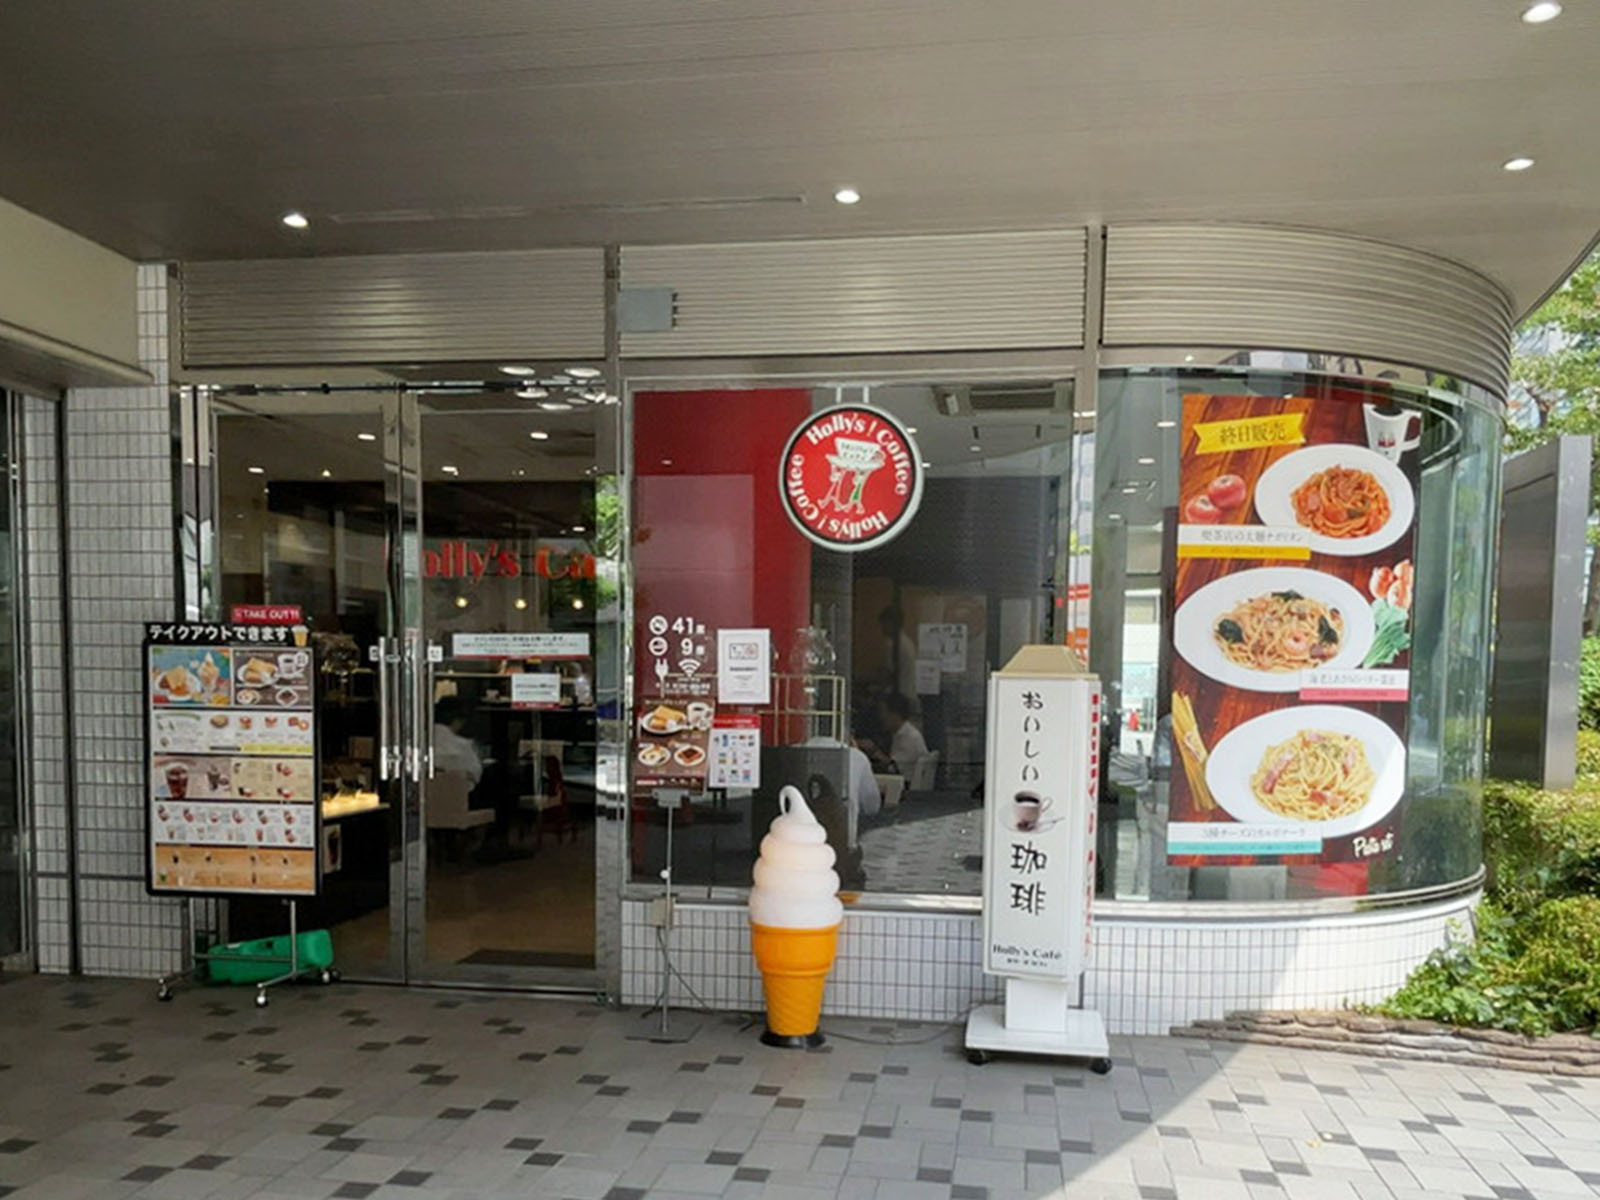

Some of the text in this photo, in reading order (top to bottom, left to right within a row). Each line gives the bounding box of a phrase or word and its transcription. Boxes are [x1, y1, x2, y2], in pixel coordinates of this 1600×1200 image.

[1221, 421, 1286, 445] 終日販売
[876, 429, 911, 495] Coffee
[383, 541, 522, 584] olly's
[150, 625, 288, 641] テイクアウトできます
[1021, 690, 1044, 782] おいしい
[1010, 841, 1047, 916] 珈琲
